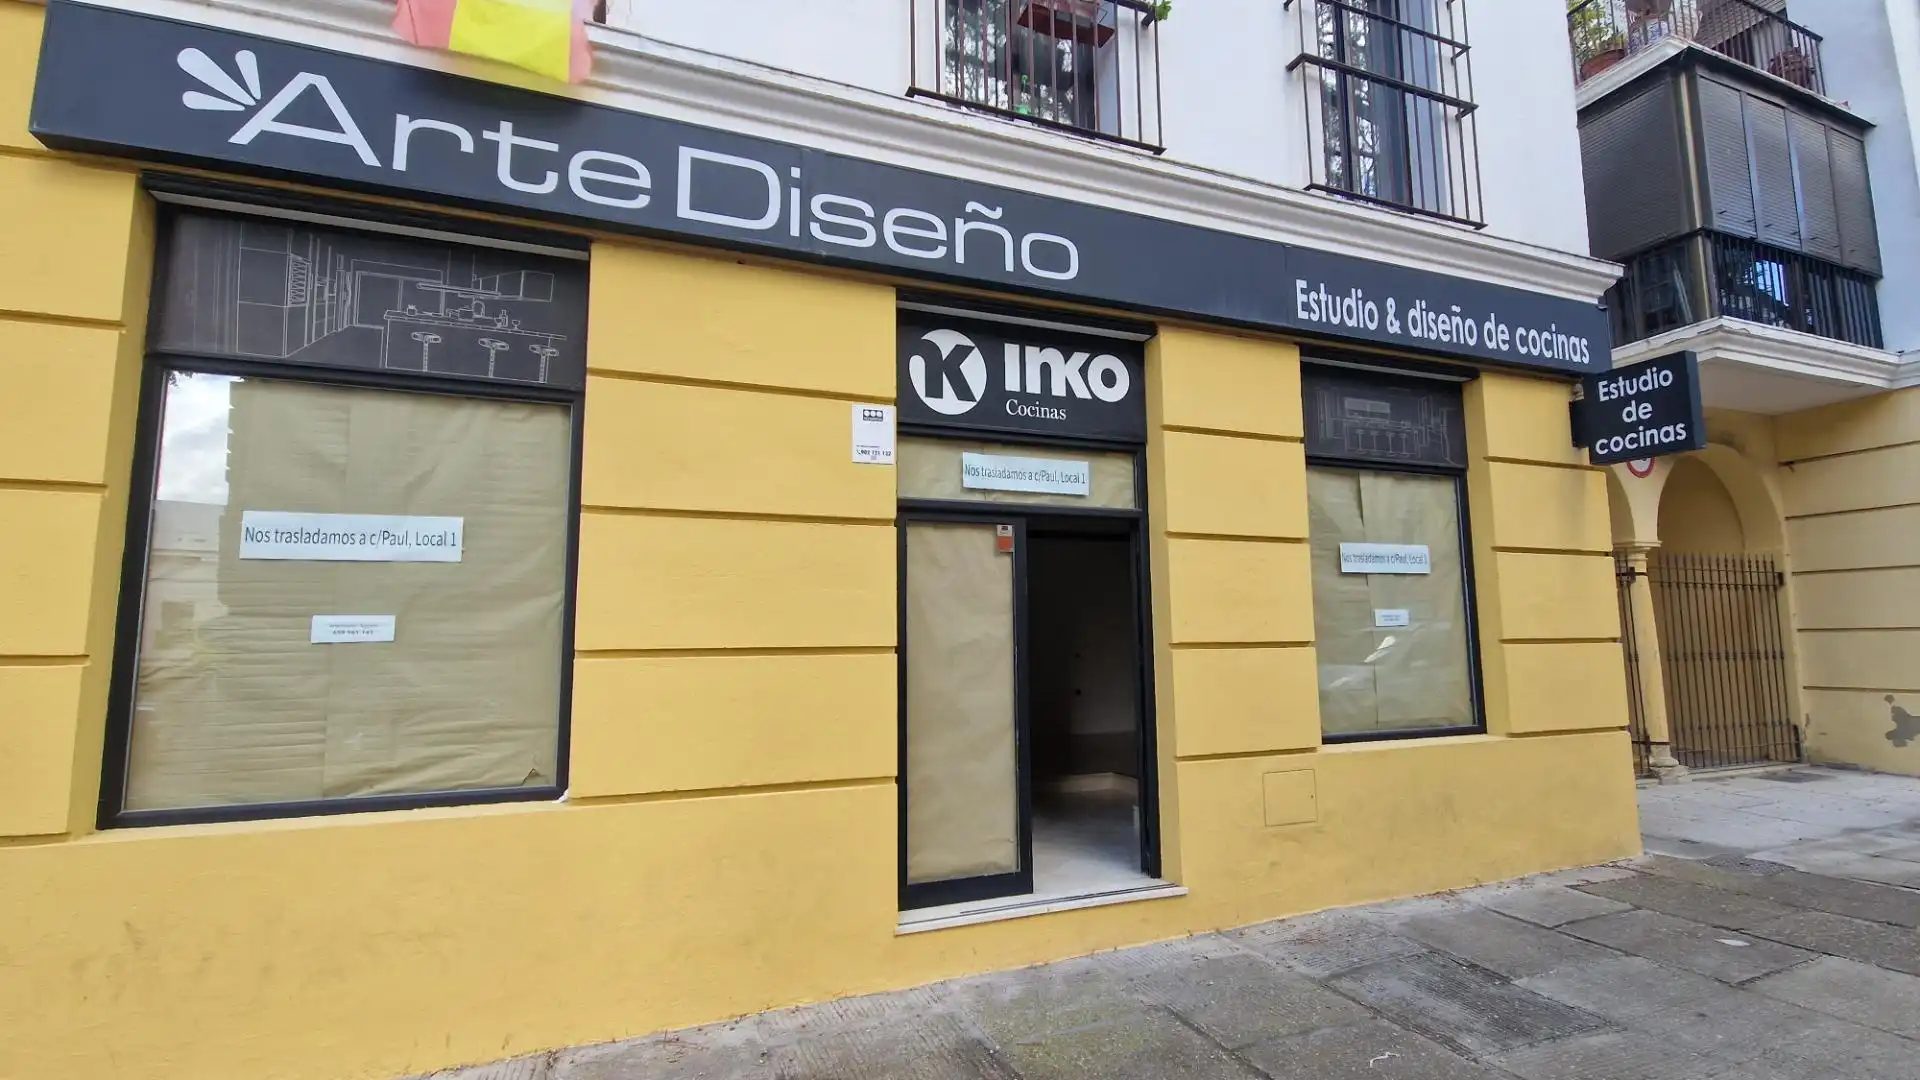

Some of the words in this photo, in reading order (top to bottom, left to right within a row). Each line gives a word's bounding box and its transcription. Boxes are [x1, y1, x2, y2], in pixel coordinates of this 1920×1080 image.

[228, 71, 652, 209] Arte
[676, 145, 1079, 281] Diseño
[1295, 279, 1379, 331] Estudio
[1386, 297, 1401, 334] &
[1408, 300, 1478, 346] diseño
[1484, 312, 1509, 351] de
[1515, 323, 1590, 364] cocinas
[1597, 367, 1673, 401] Estudio
[1005, 399, 1067, 421] Cocinas
[1622, 400, 1653, 423] de
[1595, 422, 1687, 455] cocinas
[965, 464, 980, 477] Nos
[981, 466, 1026, 481] trasladamos
[1028, 473, 1032, 481] a
[1060, 472, 1080, 484] Local
[1081, 473, 1086, 484] 1
[244, 526, 271, 543] Nos
[274, 527, 355, 546] trasladamos
[359, 533, 366, 546] a
[369, 529, 412, 548] c/Paul,
[416, 531, 447, 547] Local
[451, 532, 457, 547] 1
